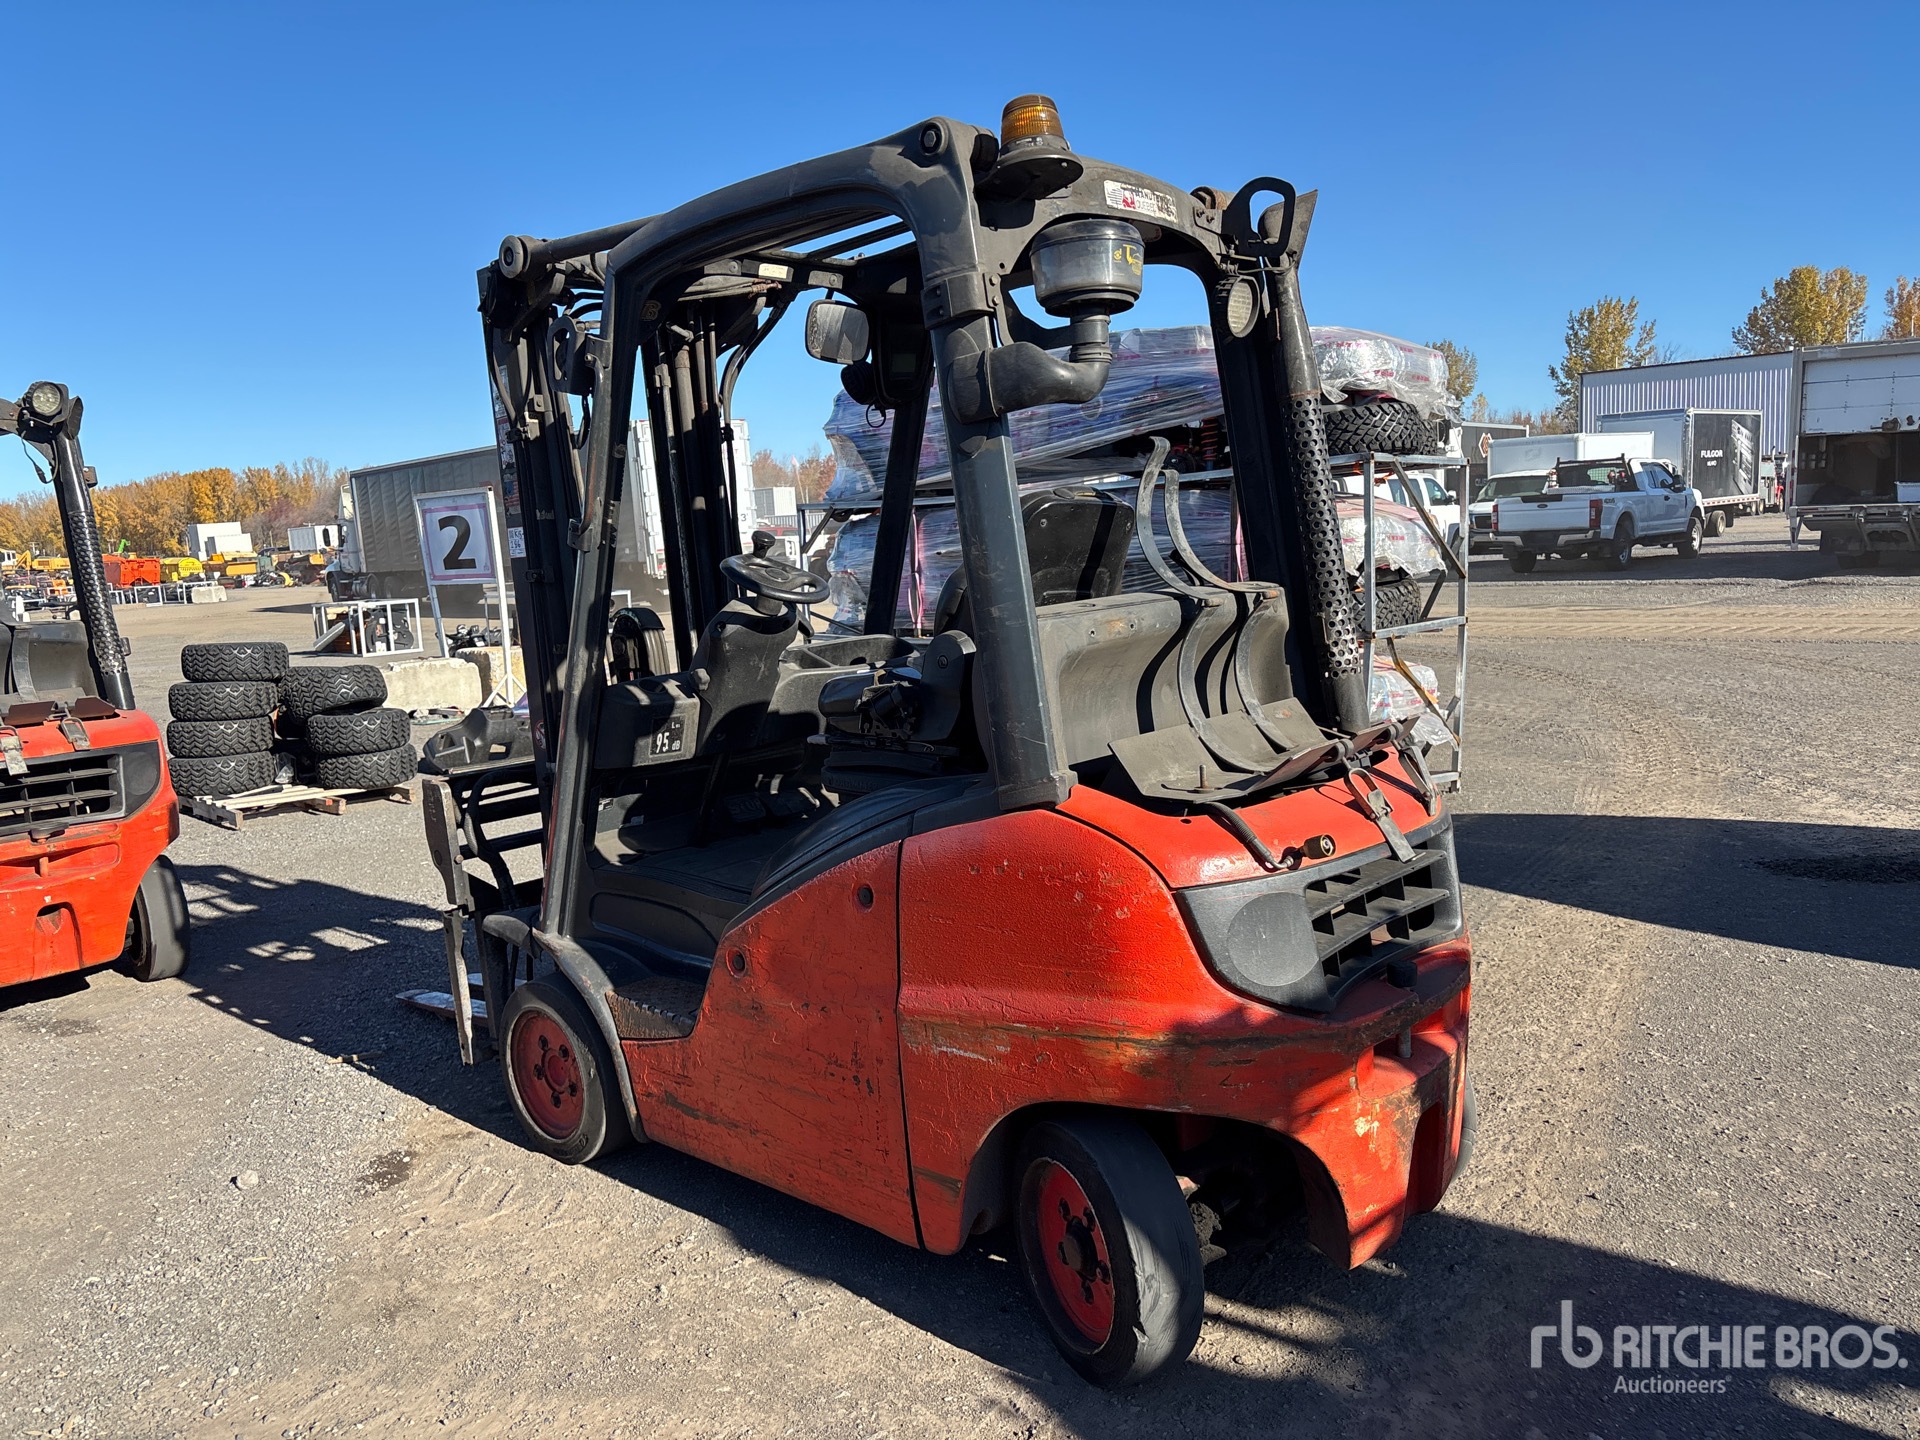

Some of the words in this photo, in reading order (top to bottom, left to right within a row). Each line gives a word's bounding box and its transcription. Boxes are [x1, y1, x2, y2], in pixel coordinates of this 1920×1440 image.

[438, 515, 477, 571] 2
[656, 732, 670, 753] 95
[671, 740, 681, 751] dB
